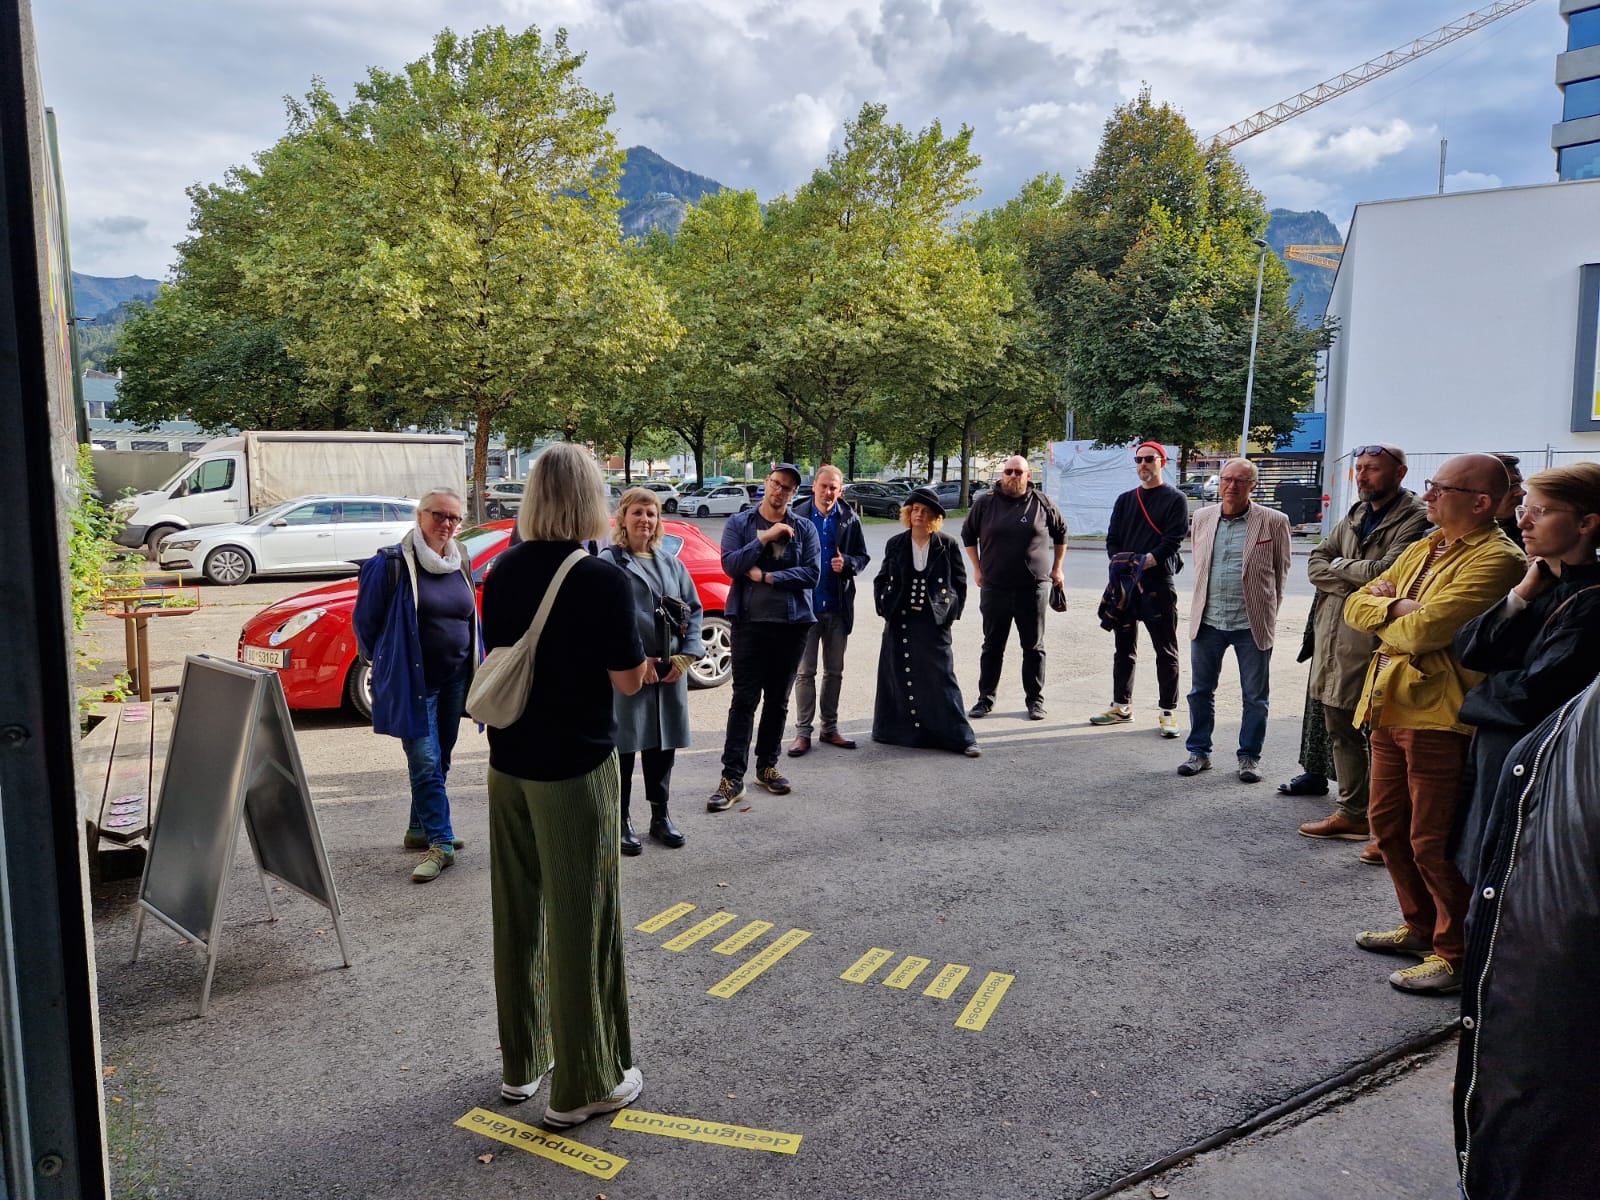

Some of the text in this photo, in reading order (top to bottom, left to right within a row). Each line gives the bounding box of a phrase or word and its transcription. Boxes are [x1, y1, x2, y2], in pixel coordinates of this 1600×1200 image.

[643, 905, 689, 929] Reduce
[670, 914, 729, 947] Refurbish
[720, 922, 766, 951] Rethink
[718, 931, 804, 993] Remanufacture
[849, 951, 886, 978] Refuse
[892, 959, 922, 984] Reuse
[934, 966, 962, 995] Repair
[965, 975, 1006, 1025] Repurpose
[471, 1114, 614, 1172] CampusVäre
[623, 1114, 792, 1148] designforum
